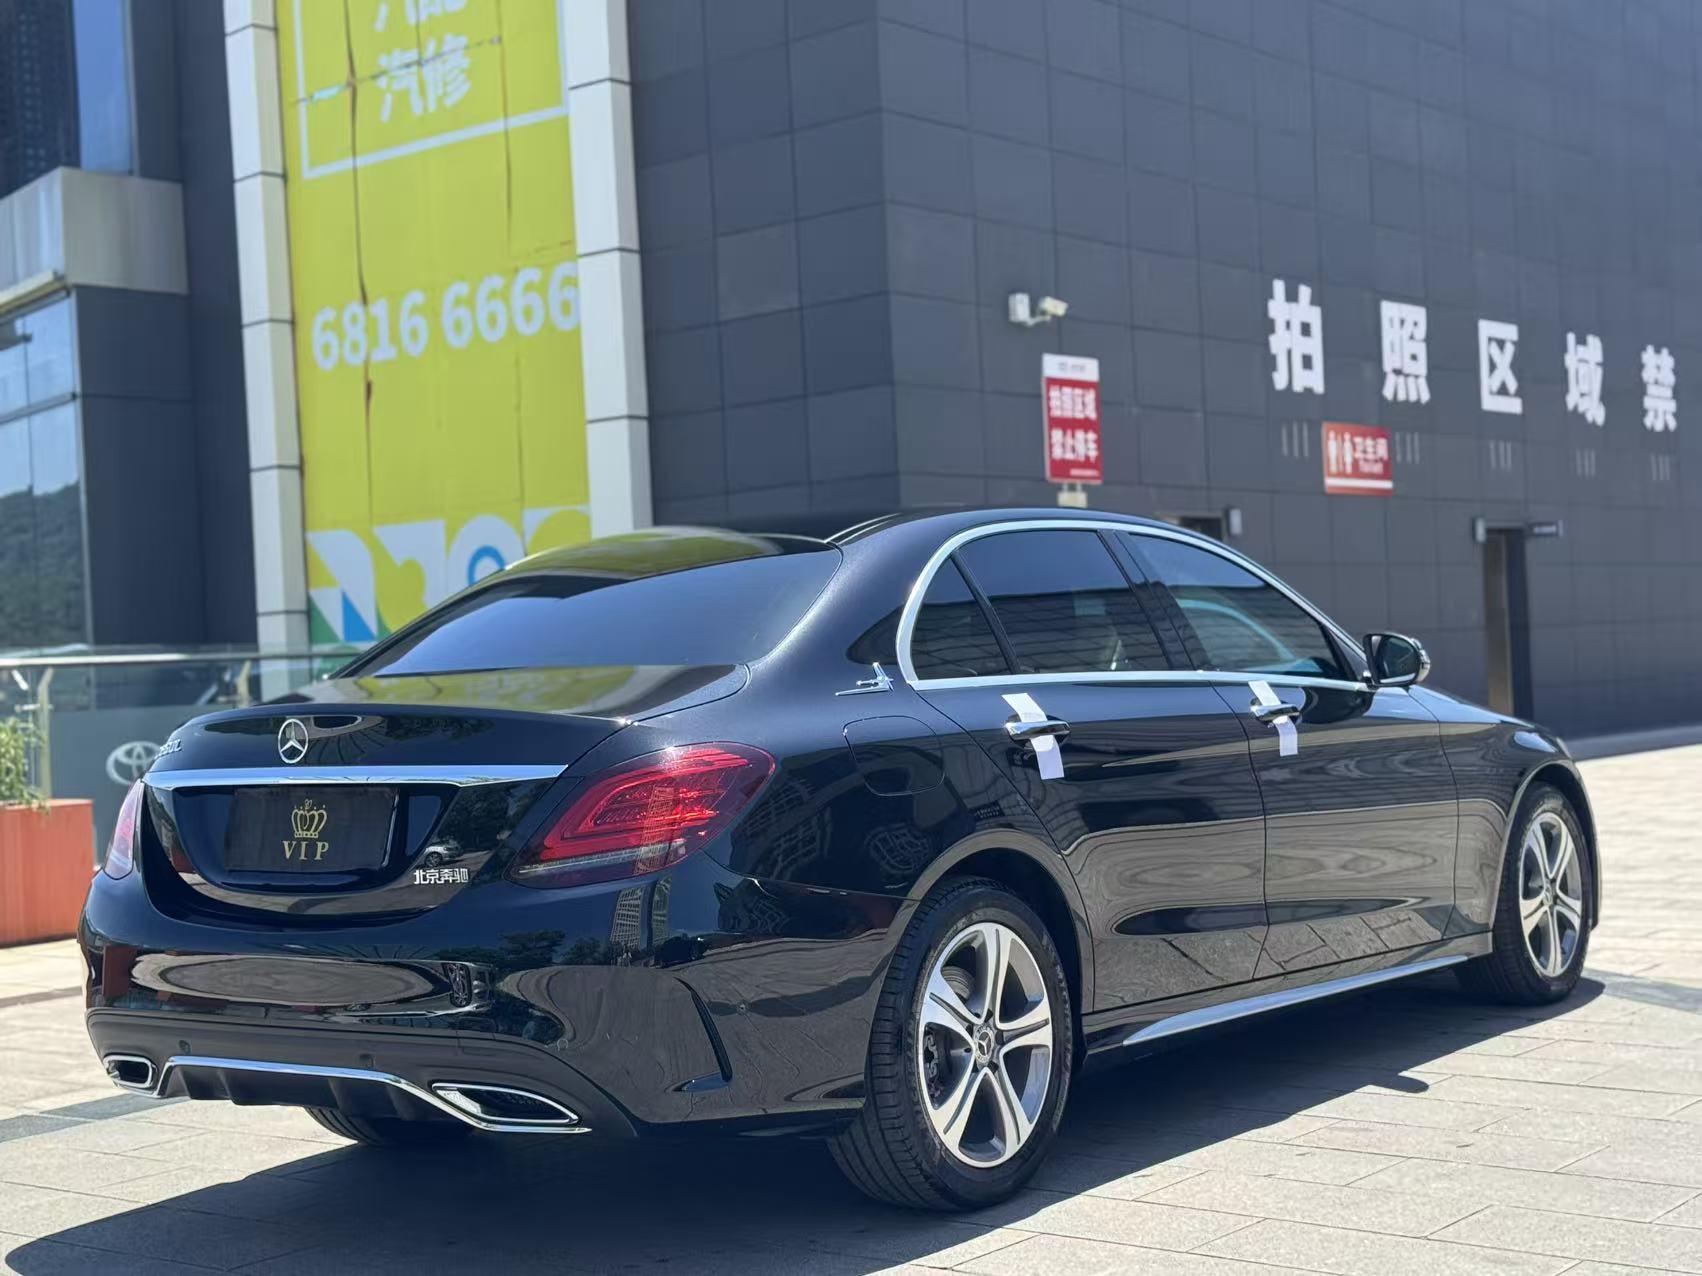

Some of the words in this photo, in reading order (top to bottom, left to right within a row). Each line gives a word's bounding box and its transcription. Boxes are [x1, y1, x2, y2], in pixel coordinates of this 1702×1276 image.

[377, 32, 471, 123] 汽修
[311, 290, 429, 371] 6816
[441, 260, 580, 348] 6666
[1353, 436, 1388, 461] 卫生间
[282, 840, 329, 861] VIP
[413, 868, 469, 885] 北京奔驰
